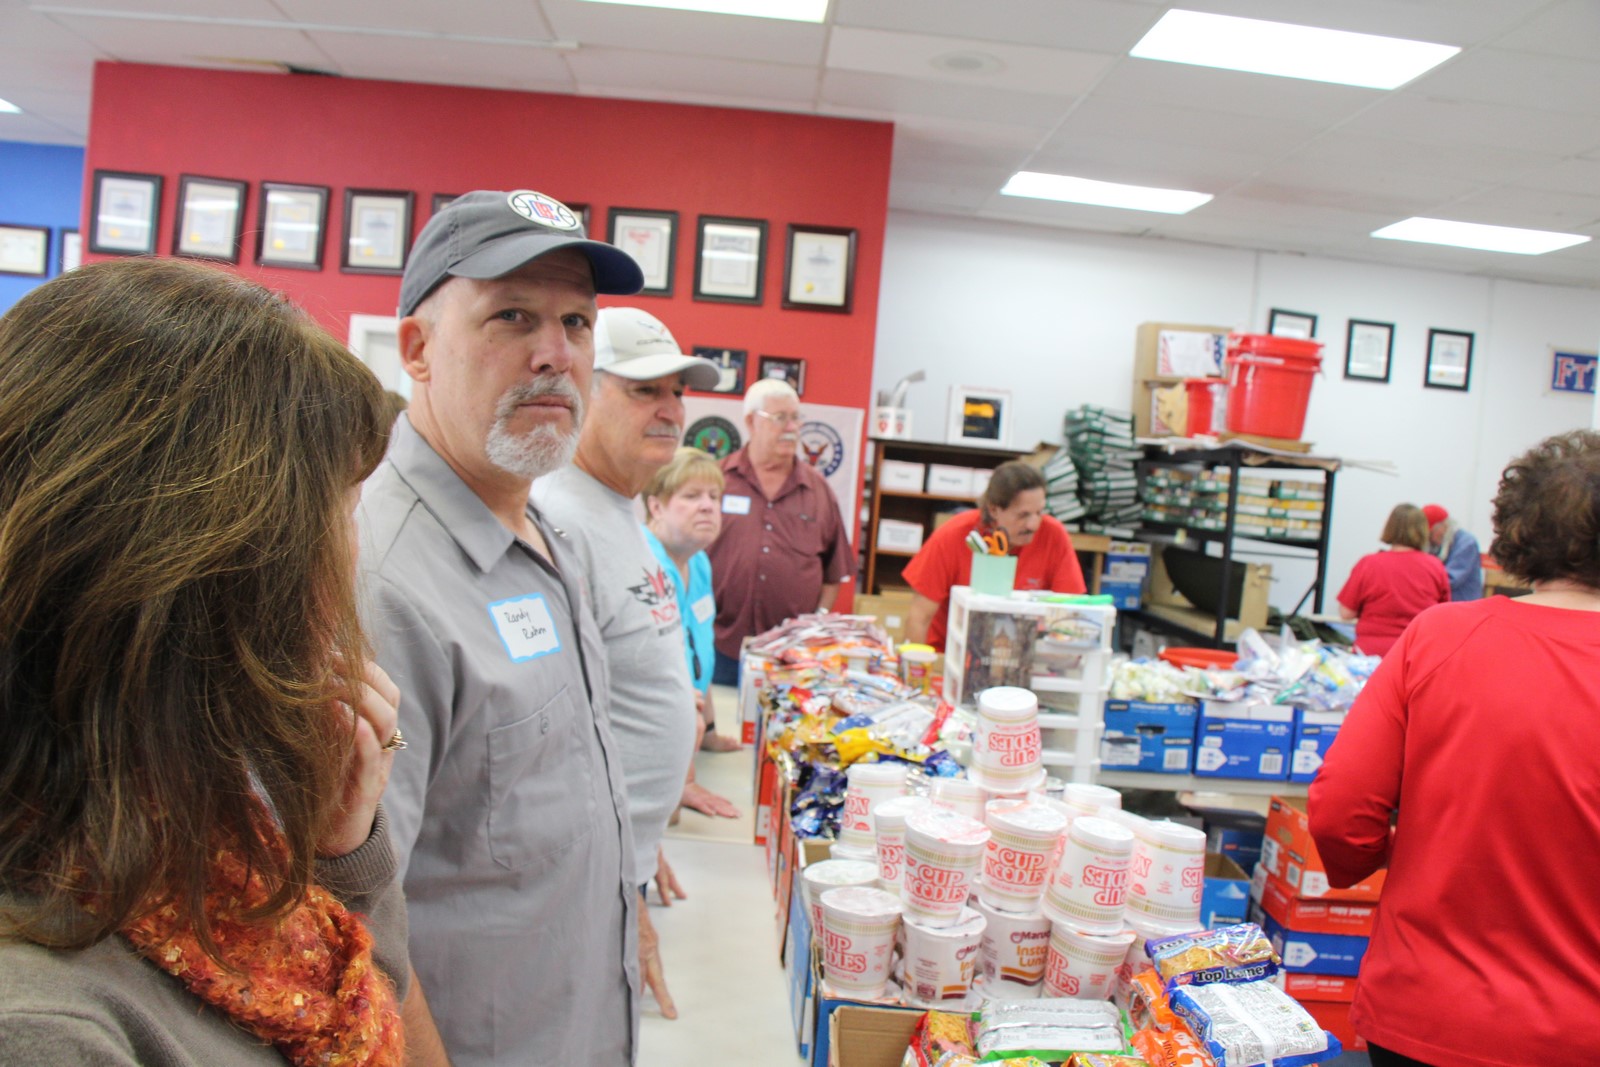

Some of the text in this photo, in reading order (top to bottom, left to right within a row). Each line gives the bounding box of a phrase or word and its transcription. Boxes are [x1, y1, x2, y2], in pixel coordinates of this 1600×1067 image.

[503, 608, 531, 623] Randy
[988, 729, 1041, 752] ODLES
[999, 848, 1045, 870] CUP
[917, 864, 964, 887] CUP
[1082, 864, 1130, 888] DLES
[904, 872, 970, 903] NOODLES
[824, 929, 852, 953] UP
[1022, 930, 1050, 940] Maruc
[824, 950, 867, 973] DLES
[1016, 944, 1048, 956] Insta
[1019, 956, 1047, 967] Lun
[1046, 946, 1069, 971] UP
[1044, 967, 1080, 995] DLES
[1196, 970, 1222, 983] Top
